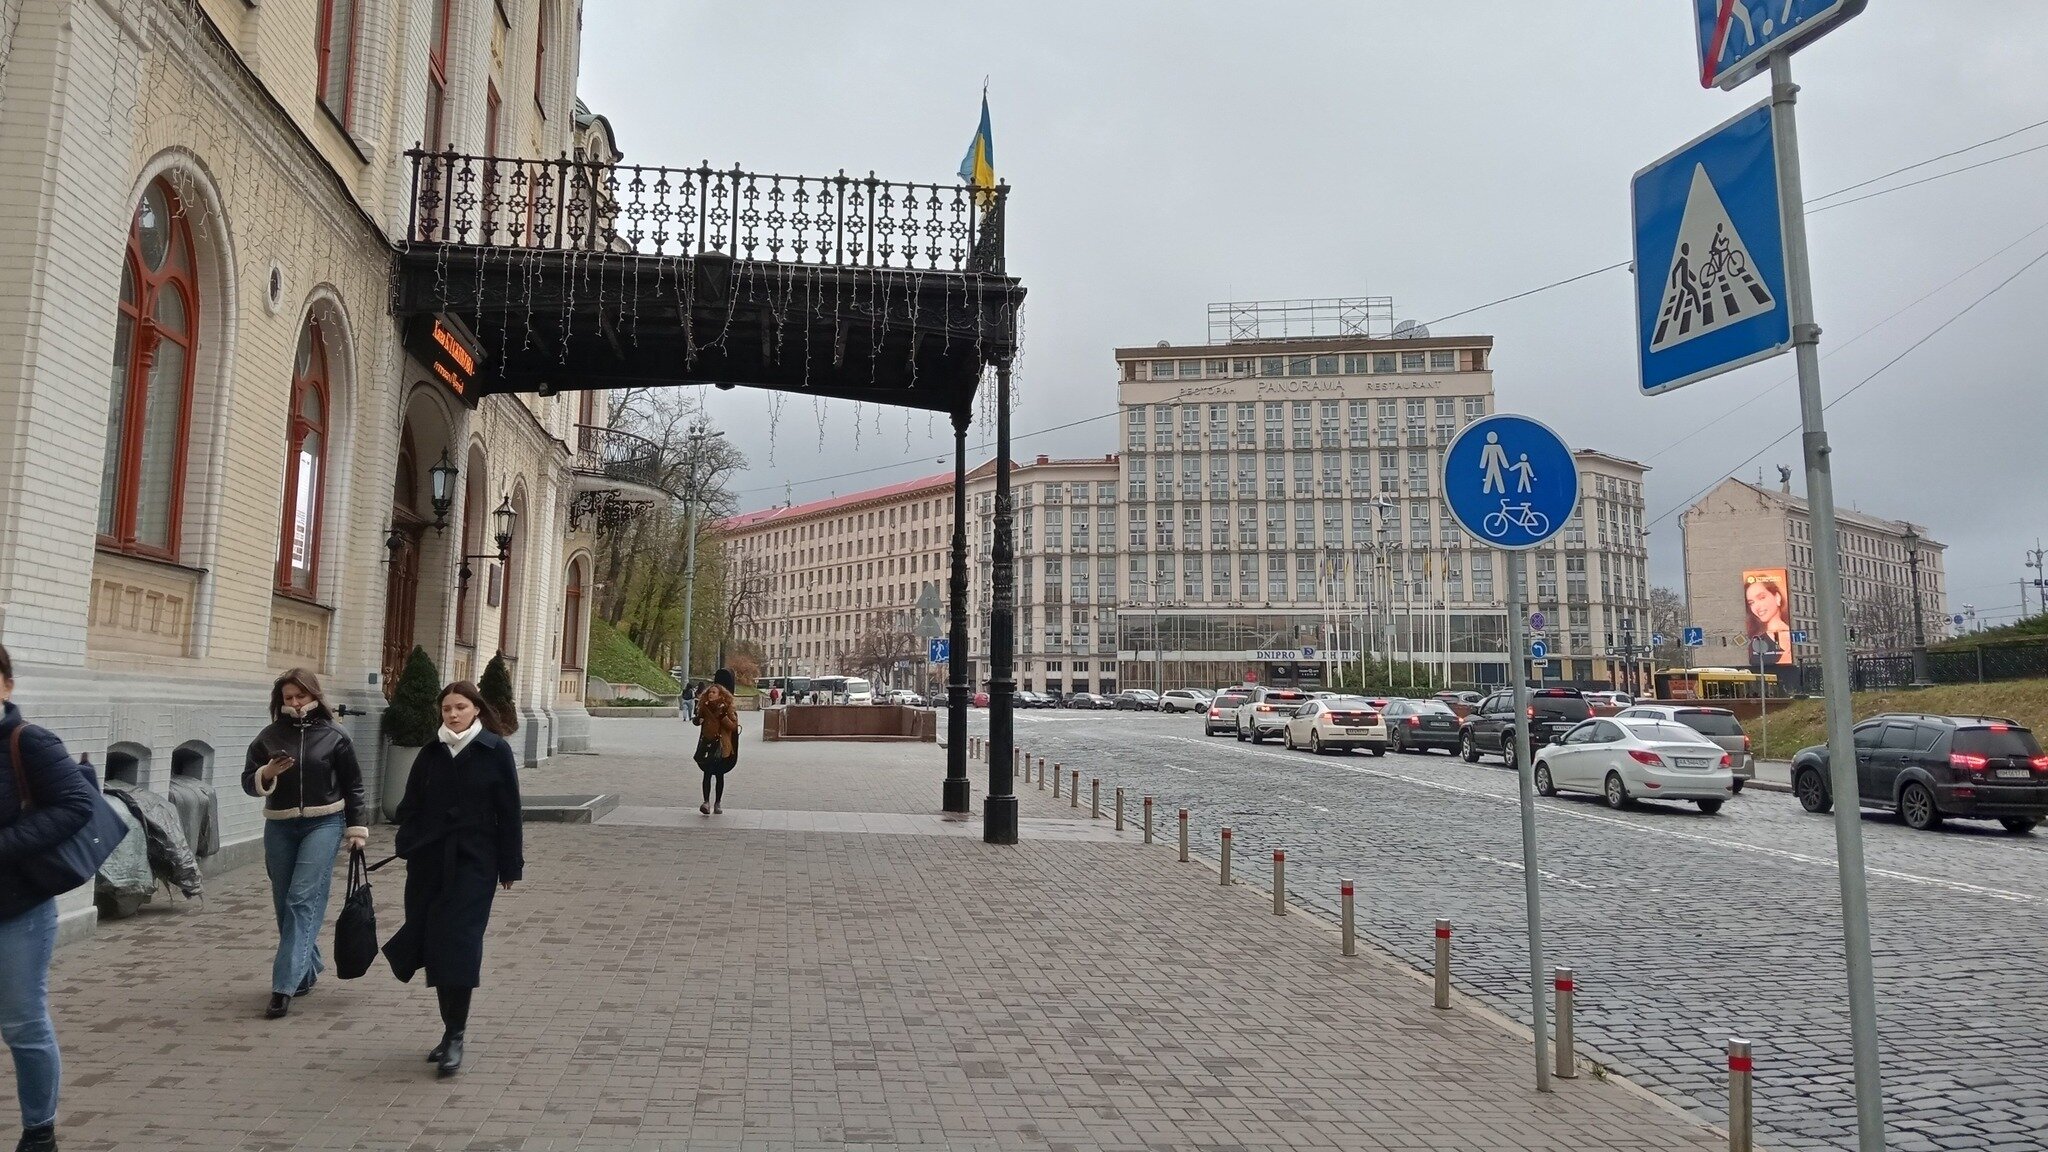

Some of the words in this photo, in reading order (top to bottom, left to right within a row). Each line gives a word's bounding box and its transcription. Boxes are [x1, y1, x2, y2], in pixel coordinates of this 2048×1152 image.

[1256, 380, 1346, 394] PANORAMA
[1366, 380, 1442, 391] RESTAURANT
[1256, 651, 1295, 659] DNIPRO
[1322, 651, 1361, 660] ДНПРО
